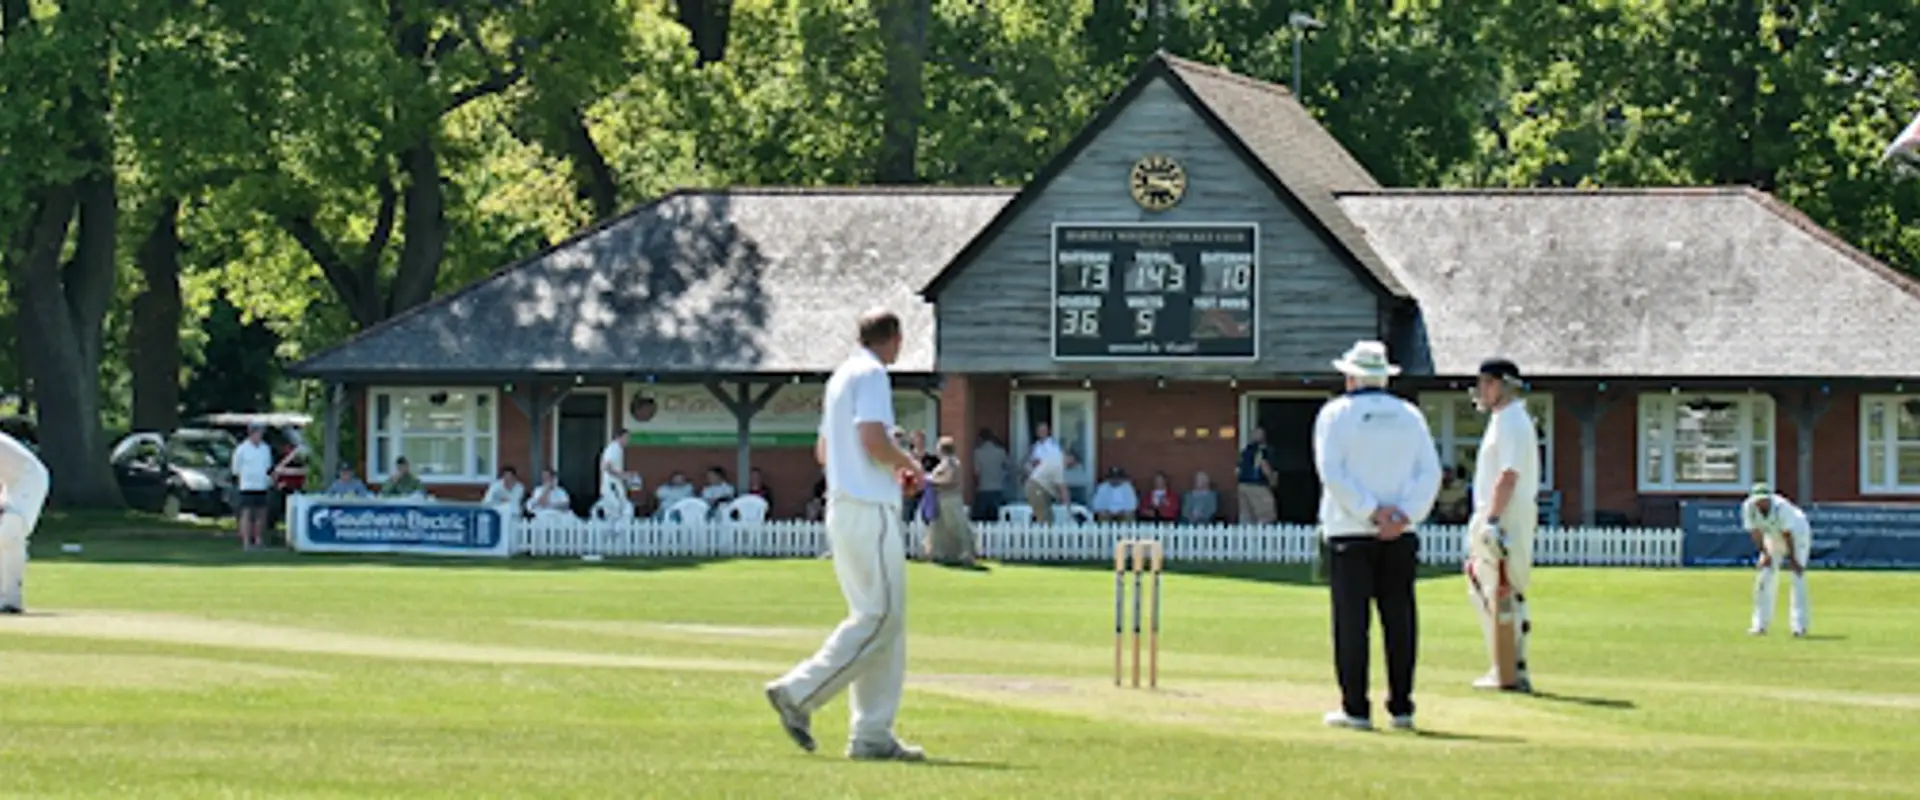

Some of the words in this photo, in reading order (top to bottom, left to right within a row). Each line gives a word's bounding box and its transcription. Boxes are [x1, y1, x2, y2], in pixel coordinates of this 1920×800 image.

[1080, 265, 1108, 290] 13
[1135, 264, 1186, 291] 143
[1221, 264, 1250, 291] 10
[1062, 310, 1098, 335] 36
[1136, 309, 1153, 336] 5
[331, 509, 405, 529] Southern
[407, 509, 466, 531] Electric
